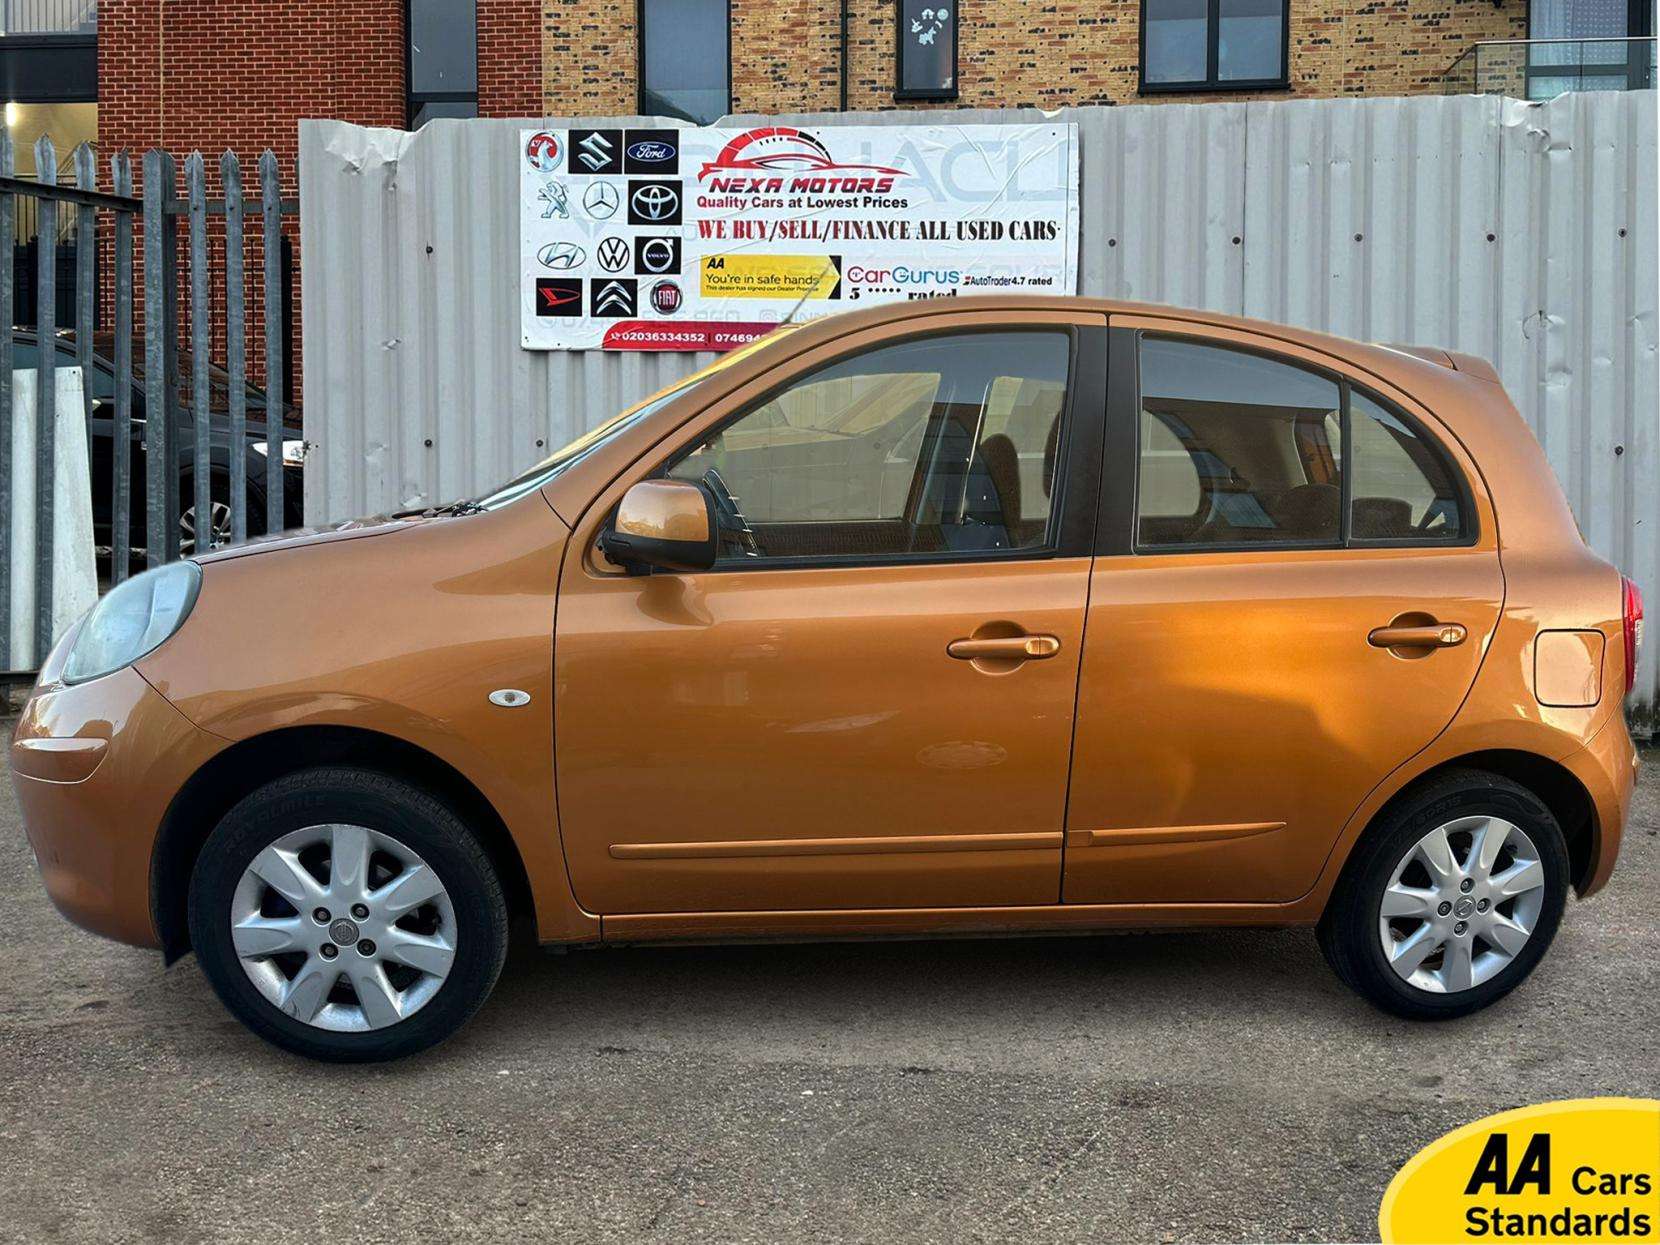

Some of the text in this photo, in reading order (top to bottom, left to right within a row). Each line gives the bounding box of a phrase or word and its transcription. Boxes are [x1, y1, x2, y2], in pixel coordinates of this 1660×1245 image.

[636, 144, 667, 158] Ford
[709, 177, 894, 193] NEXA MOTORS
[697, 197, 908, 210] Quality Cars at Lowest Prices
[697, 220, 726, 240] WE
[732, 219, 910, 242] BUY/SELL/FINANCE
[915, 220, 951, 240] ALL
[957, 220, 1003, 240] USED
[707, 258, 725, 269] AA
[706, 274, 820, 285] You're in safe hands
[847, 266, 960, 284] CarGurus
[1028, 277, 1053, 286] rated
[658, 290, 677, 306] FIAT
[849, 287, 860, 300] 5
[622, 332, 705, 342] 02036334352
